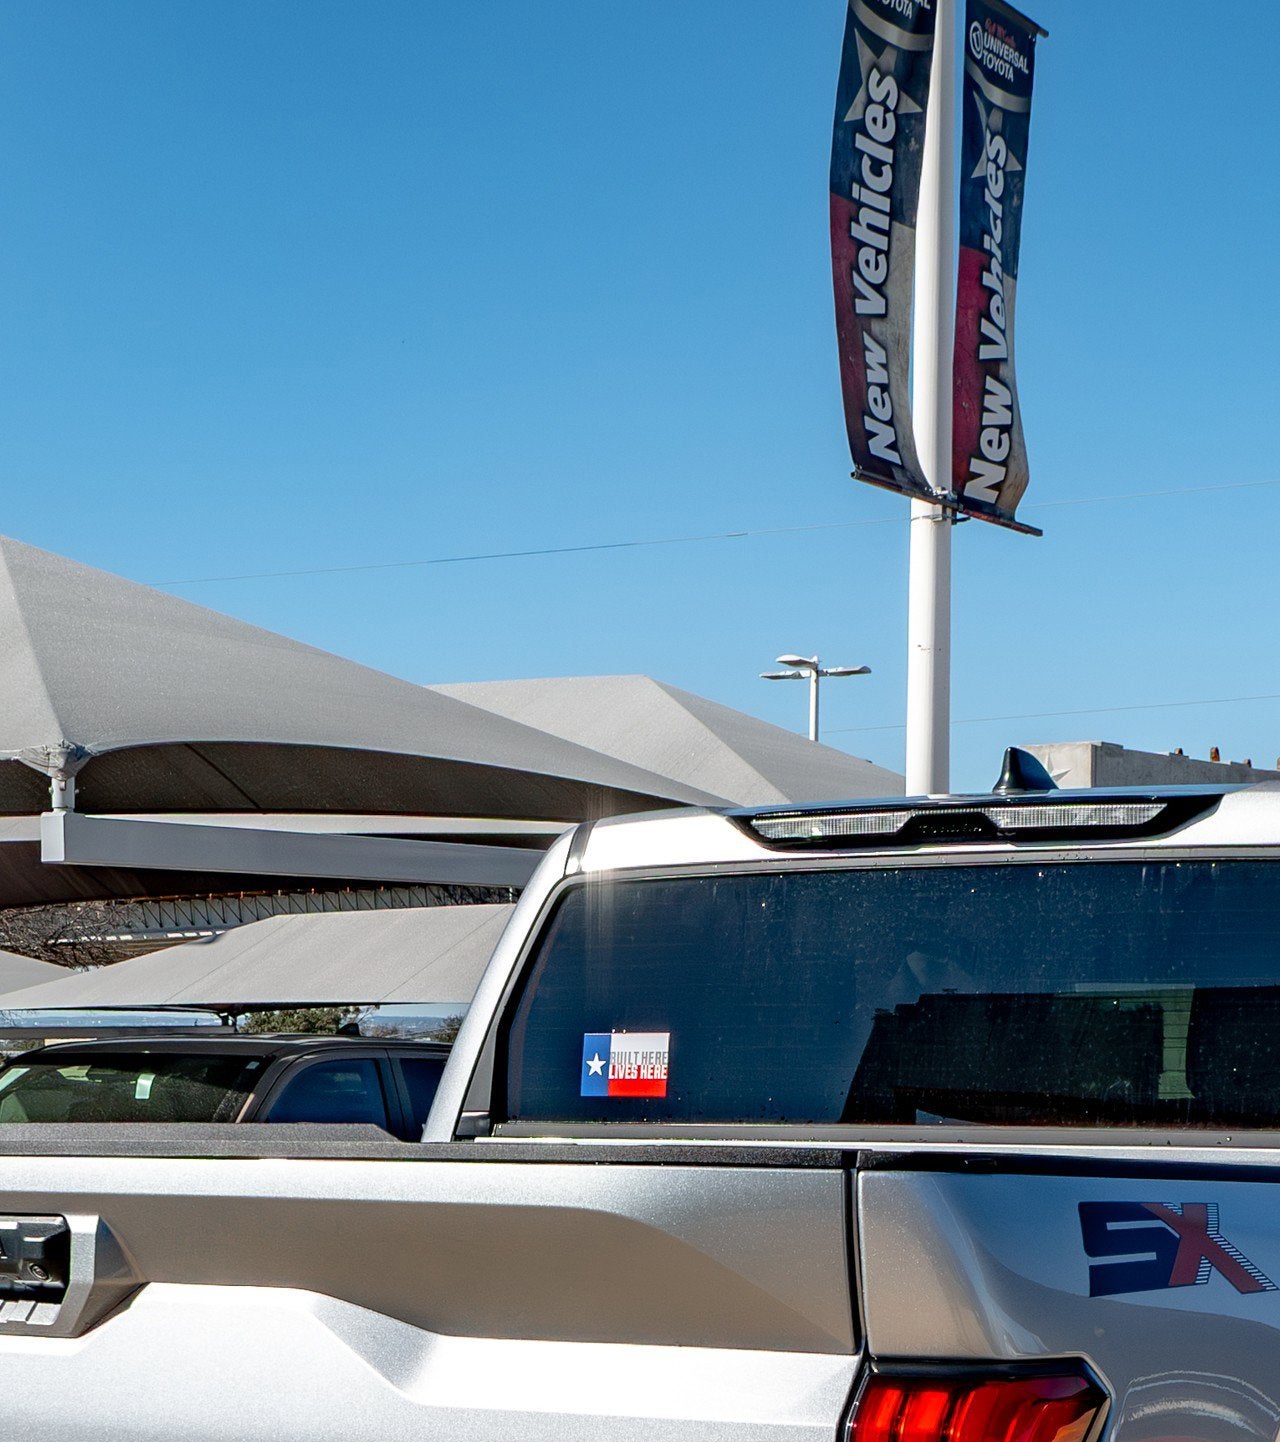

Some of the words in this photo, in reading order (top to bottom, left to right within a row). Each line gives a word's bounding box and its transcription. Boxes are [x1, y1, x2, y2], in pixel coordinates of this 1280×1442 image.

[982, 50, 1014, 83] TOYOTA
[984, 31, 1029, 74] UNIVERSAL
[851, 68, 899, 315] Vehicles
[979, 129, 1008, 360] Vehicles
[863, 331, 903, 465] New
[963, 375, 1012, 504] New
[609, 1065, 638, 1079] LIVES
[640, 1065, 668, 1080] HERE
[611, 1051, 639, 1065] BUILT
[641, 1051, 669, 1065] HERE
